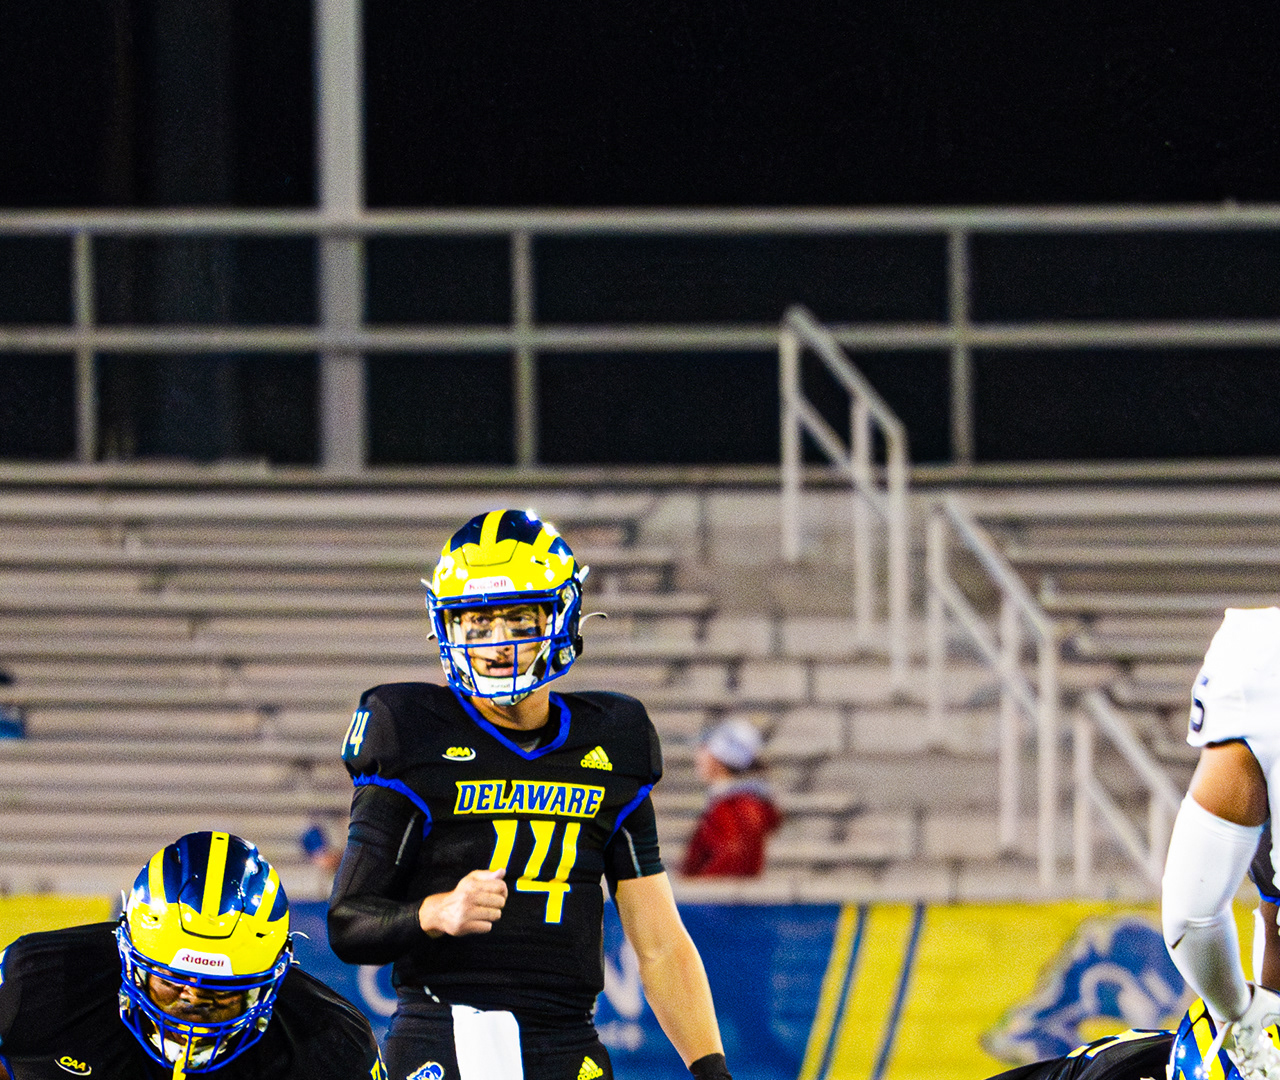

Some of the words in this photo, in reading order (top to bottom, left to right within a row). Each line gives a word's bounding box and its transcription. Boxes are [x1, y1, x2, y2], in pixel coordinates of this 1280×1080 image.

[341, 710, 371, 756] 14
[453, 779, 606, 819] DELAWARE
[488, 819, 582, 924] 14
[181, 953, 225, 968] Riddell
[59, 1055, 87, 1072] CAA
